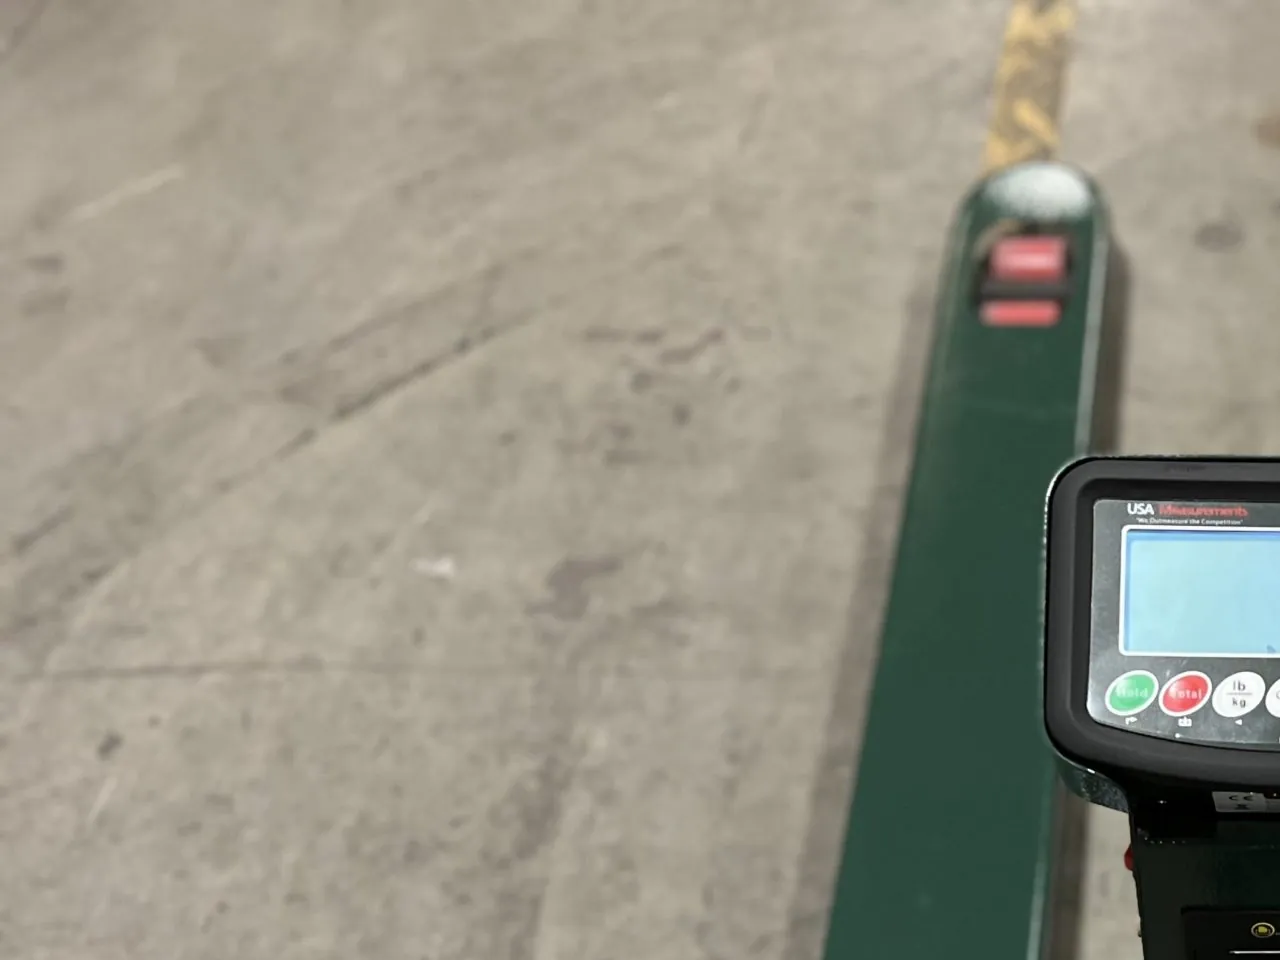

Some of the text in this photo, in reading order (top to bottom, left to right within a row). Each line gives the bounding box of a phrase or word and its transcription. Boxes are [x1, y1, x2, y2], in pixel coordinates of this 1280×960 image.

[1127, 502, 1248, 518] USA Measurements
[1190, 518, 1200, 526] the
[1232, 680, 1246, 692] lb
[1169, 687, 1203, 700] Total
[1232, 698, 1246, 709] kg
